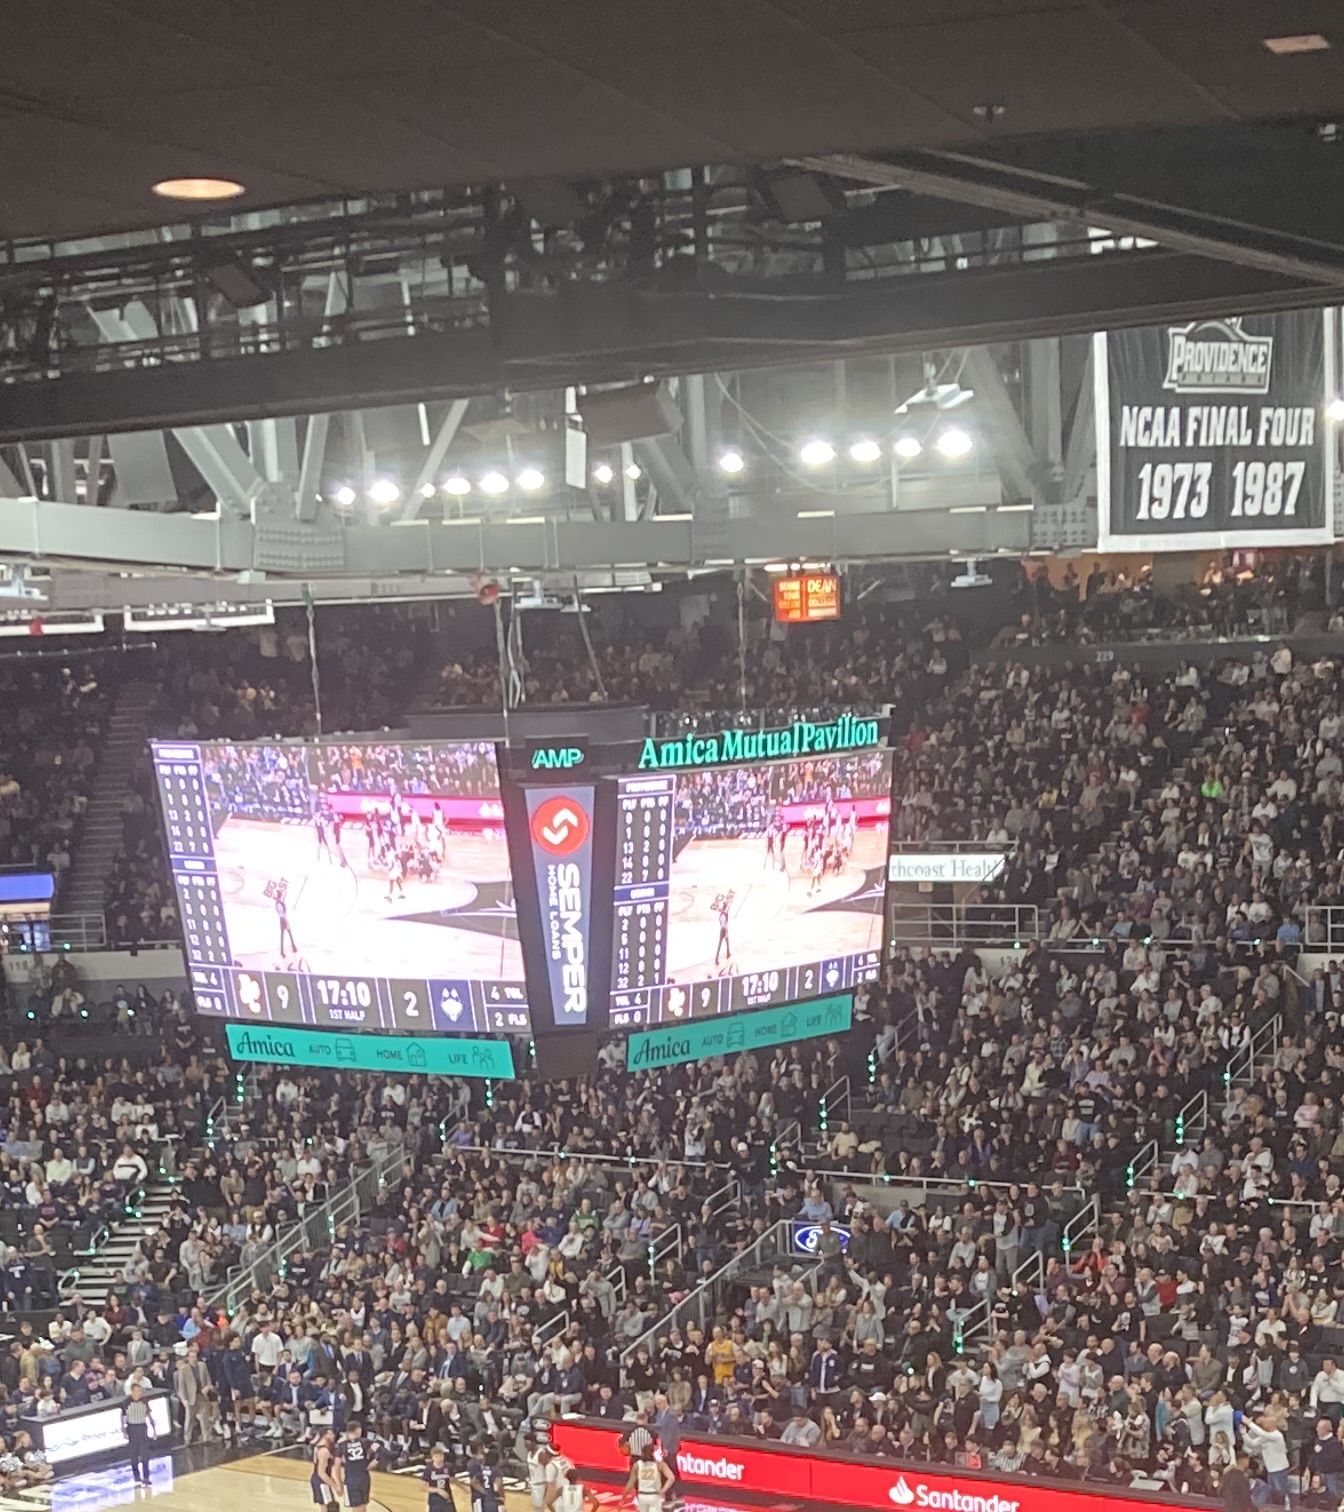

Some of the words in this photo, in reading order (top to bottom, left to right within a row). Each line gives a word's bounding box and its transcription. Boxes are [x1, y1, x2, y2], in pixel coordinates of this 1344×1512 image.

[1174, 336, 1268, 380] PROVIDENCE
[1120, 405, 1180, 447] NCAA
[1186, 406, 1253, 447] FINAL
[1257, 407, 1315, 446] FOUR
[1136, 462, 1212, 520] 1973
[1231, 461, 1306, 516] 1987
[638, 732, 718, 768] Amica
[721, 723, 802, 761] Mutual
[802, 713, 879, 752] Pavilion
[532, 748, 584, 768] AMP
[626, 827, 631, 839] 1
[624, 842, 633, 854] 13
[643, 840, 649, 852] 2
[623, 857, 633, 869] 14
[547, 865, 558, 907] HOME
[622, 872, 634, 886] 22
[642, 870, 648, 881] 7
[550, 911, 561, 960] LOANS
[558, 863, 587, 1013] SEMPER
[209, 972, 218, 985] 4
[741, 971, 779, 998] 17:10
[804, 970, 813, 989] 2
[277, 985, 289, 1009] 9
[317, 979, 371, 1007] 17:10
[491, 986, 500, 1000] 4
[634, 992, 641, 1004] 4
[701, 988, 711, 1008] 9
[214, 997, 222, 1010] 0
[404, 992, 419, 1017] 2
[329, 1009, 343, 1020] 1ST
[495, 1012, 504, 1026] 2
[633, 1010, 641, 1022] 0
[237, 1031, 296, 1058] Amica
[309, 1044, 332, 1056] AUTO
[376, 1048, 403, 1061] HOME
[449, 1053, 468, 1065] LIFE
[633, 1036, 690, 1065] Amica
[701, 1034, 723, 1048] AUTO
[755, 1023, 777, 1037] HOME
[806, 1014, 822, 1028] LIFE
[347, 1448, 364, 1461] 32
[641, 1469, 654, 1480] 22
[677, 1452, 744, 1480] ntander
